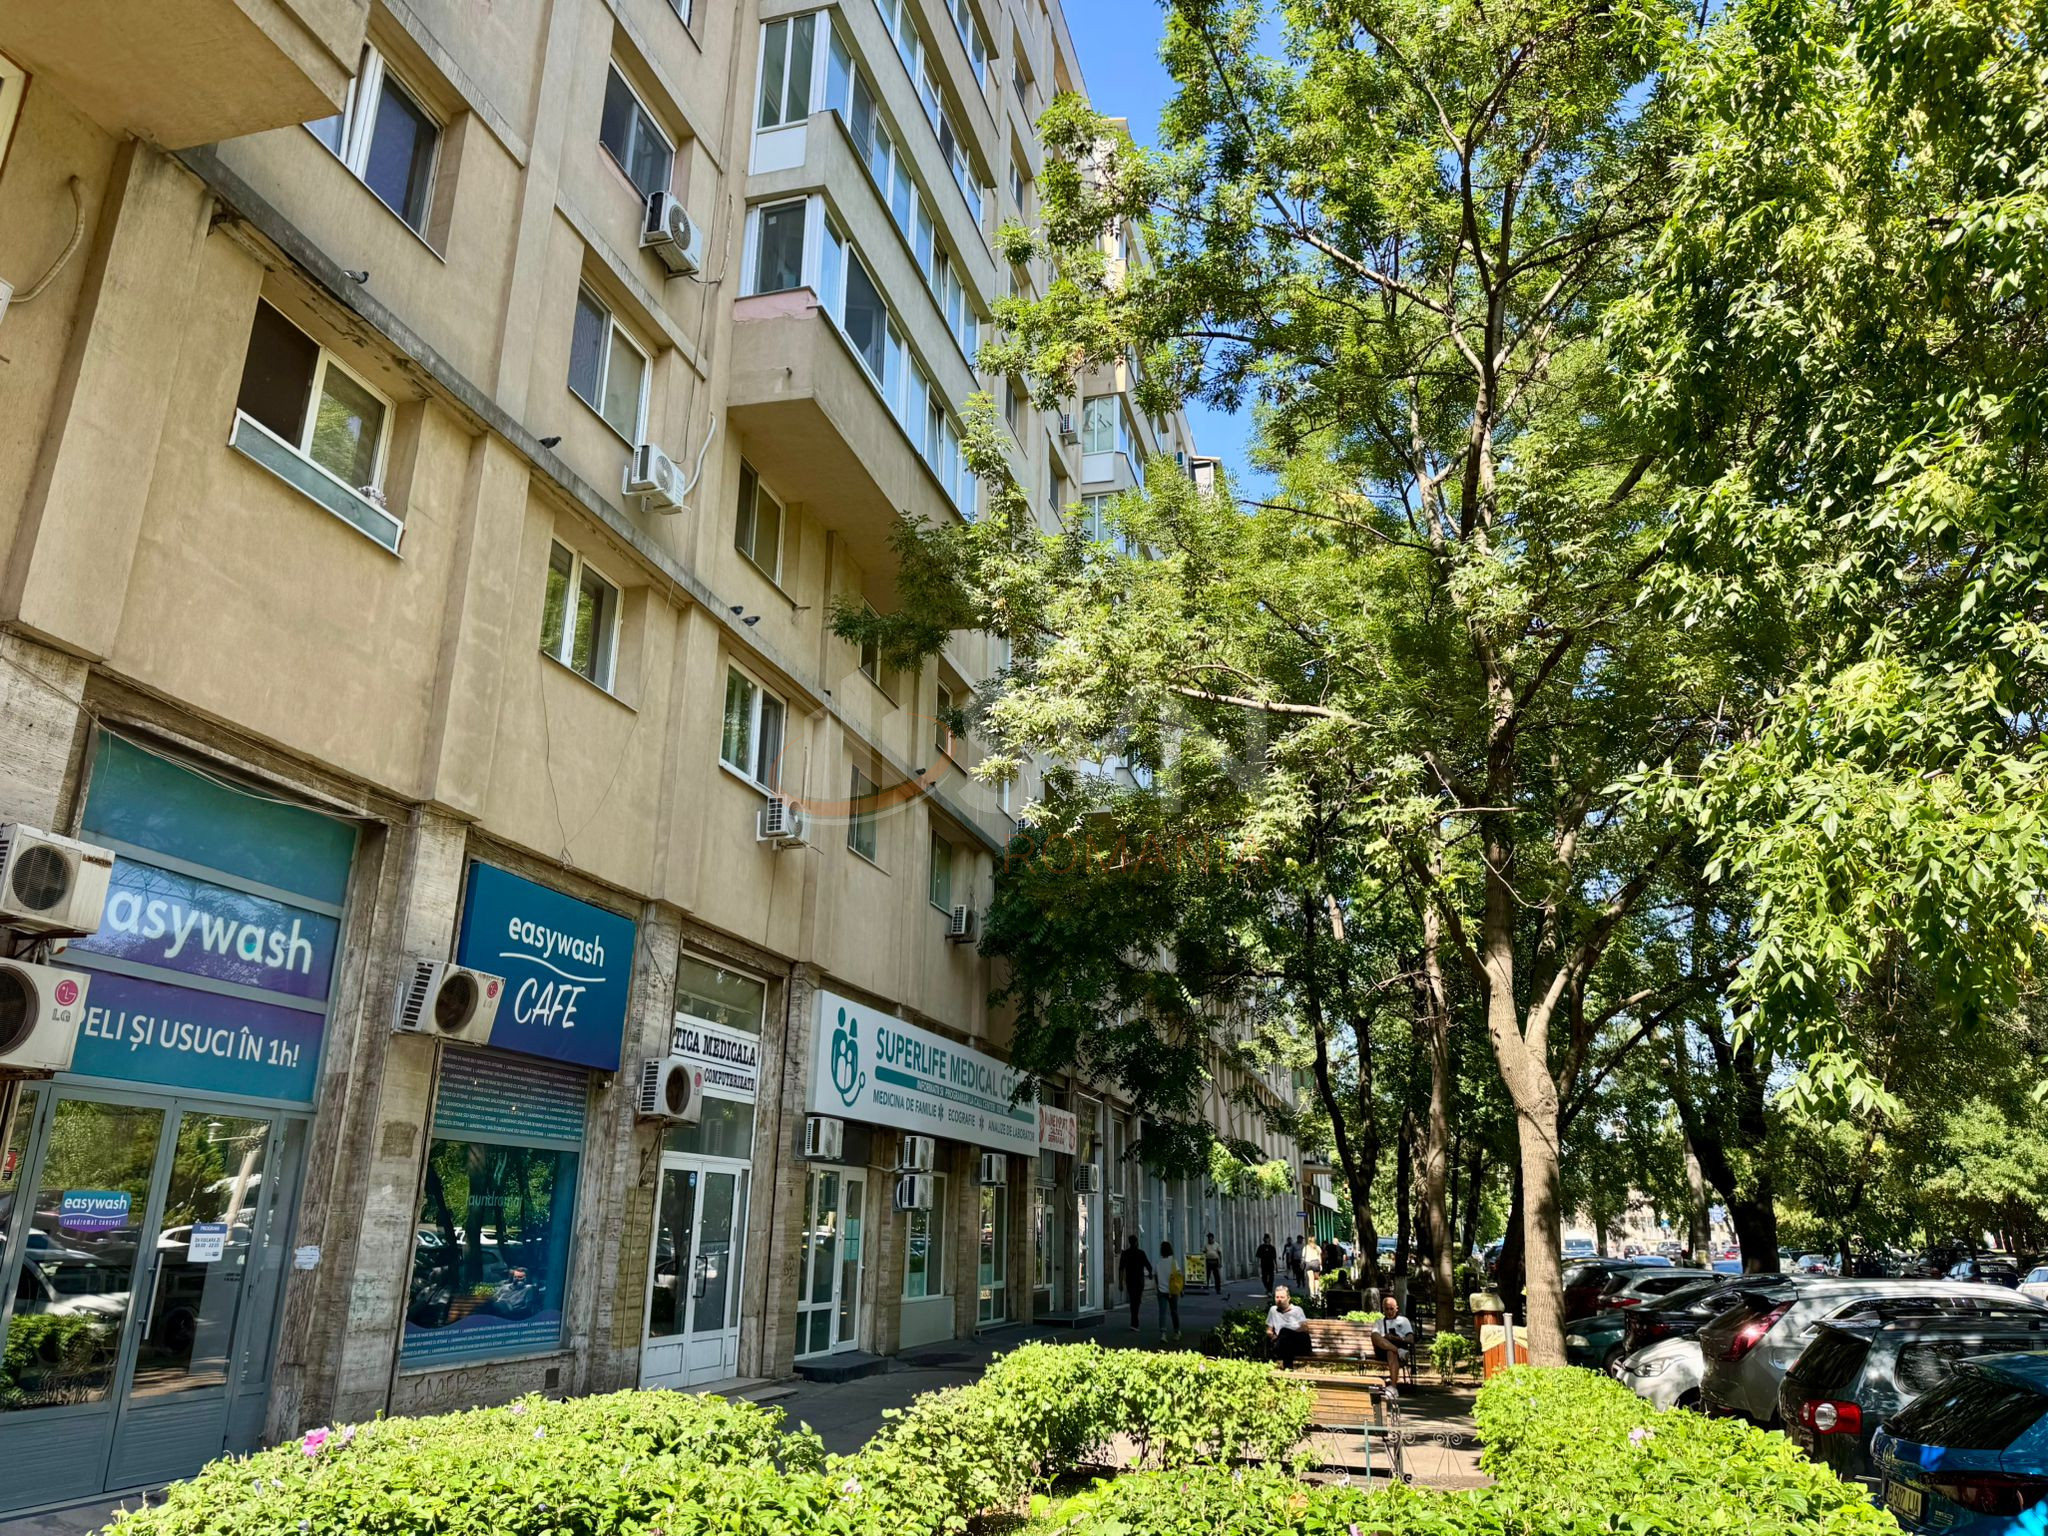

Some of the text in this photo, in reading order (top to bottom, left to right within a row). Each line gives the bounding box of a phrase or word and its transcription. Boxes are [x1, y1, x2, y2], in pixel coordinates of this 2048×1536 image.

[508, 916, 605, 967] easywash
[52, 1008, 71, 1022] LG
[514, 978, 586, 1029] CAFE
[160, 1020, 234, 1056] USUCI
[239, 1026, 263, 1063] ÎN
[267, 1040, 300, 1068] 1h!
[702, 1035, 756, 1067] MEDICALA
[876, 1026, 946, 1079] SUPERLIFE
[949, 1054, 997, 1097] MEDICAL
[873, 1089, 905, 1110] MEDICINA
[906, 1098, 914, 1111] DE
[915, 1101, 937, 1118] FAMILIE
[948, 1108, 976, 1126] ECOGRAFIE
[63, 1194, 127, 1212] easywash
[1888, 1482, 1894, 1502] B
